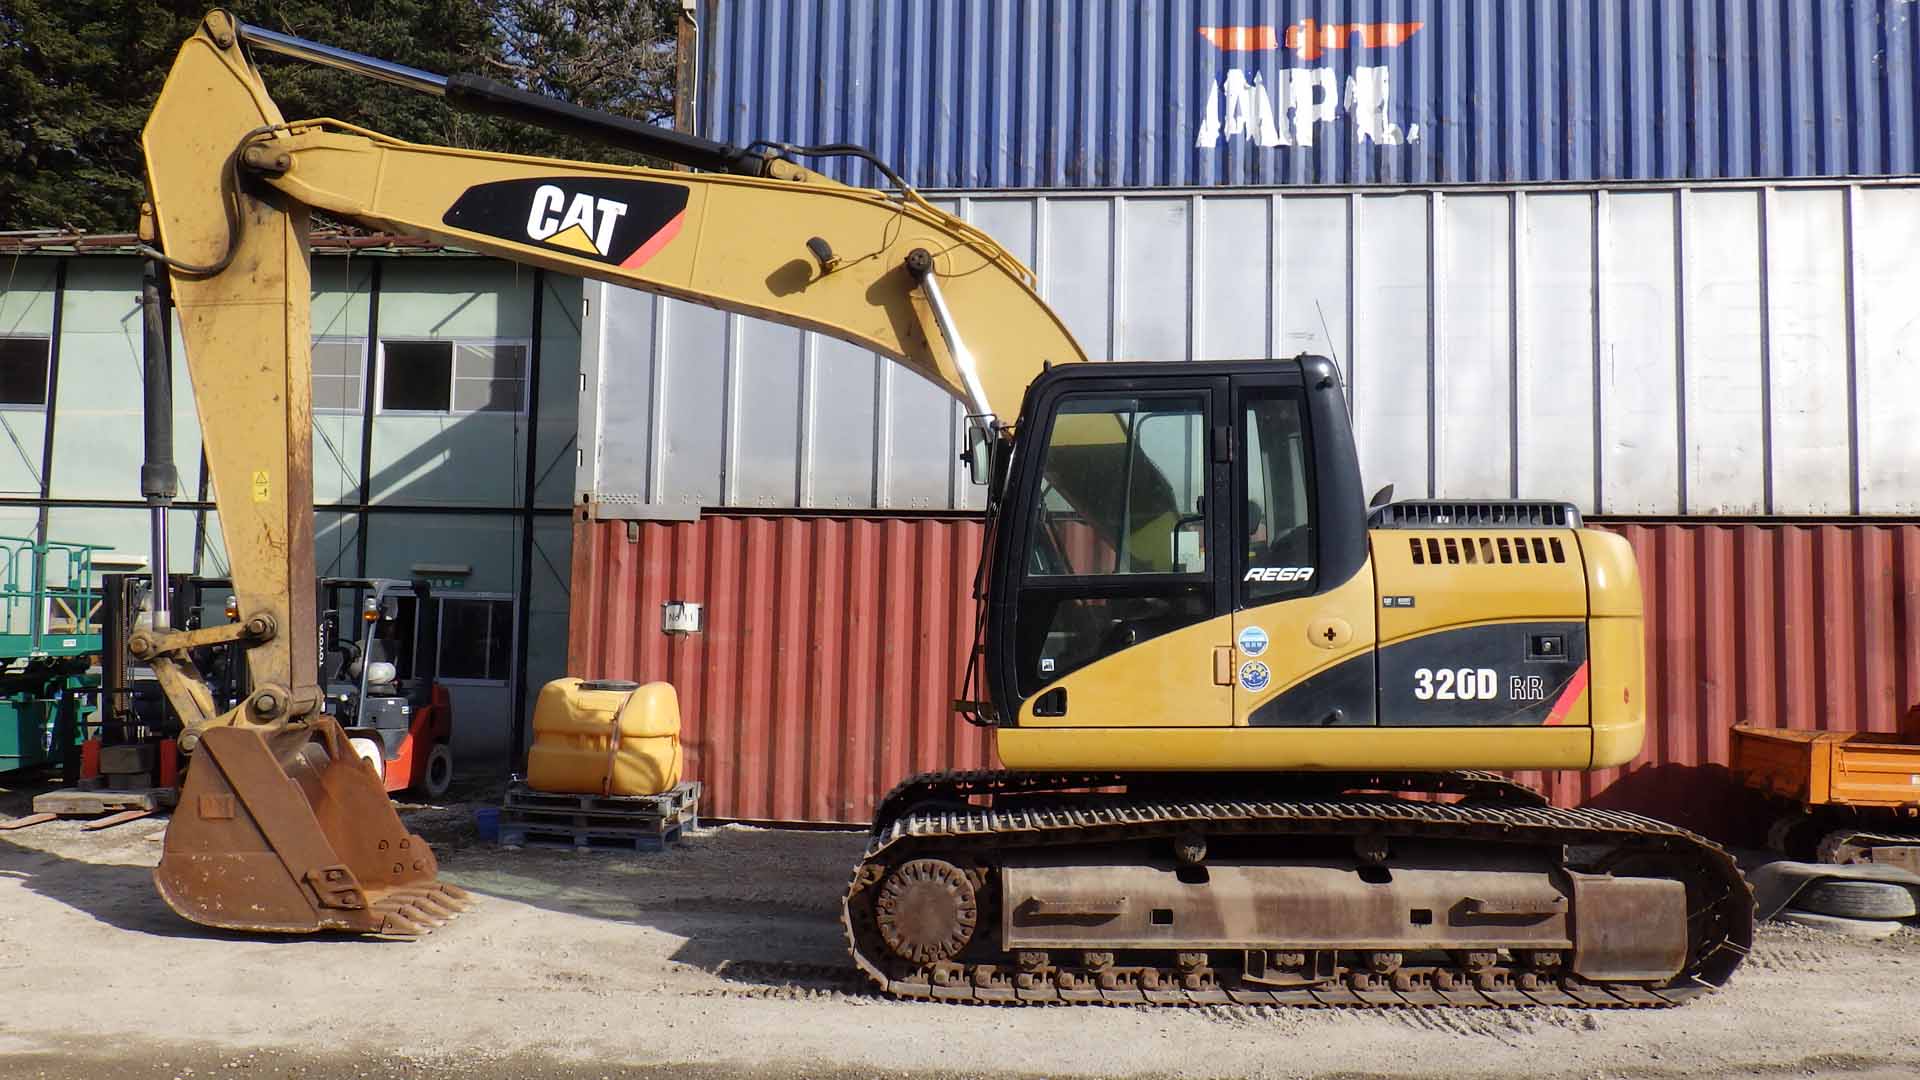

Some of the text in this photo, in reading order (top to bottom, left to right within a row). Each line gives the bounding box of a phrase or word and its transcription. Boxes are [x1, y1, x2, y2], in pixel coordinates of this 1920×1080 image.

[526, 184, 628, 257] CAT
[1243, 567, 1314, 582] REGA
[1414, 668, 1543, 700] 320D RR
